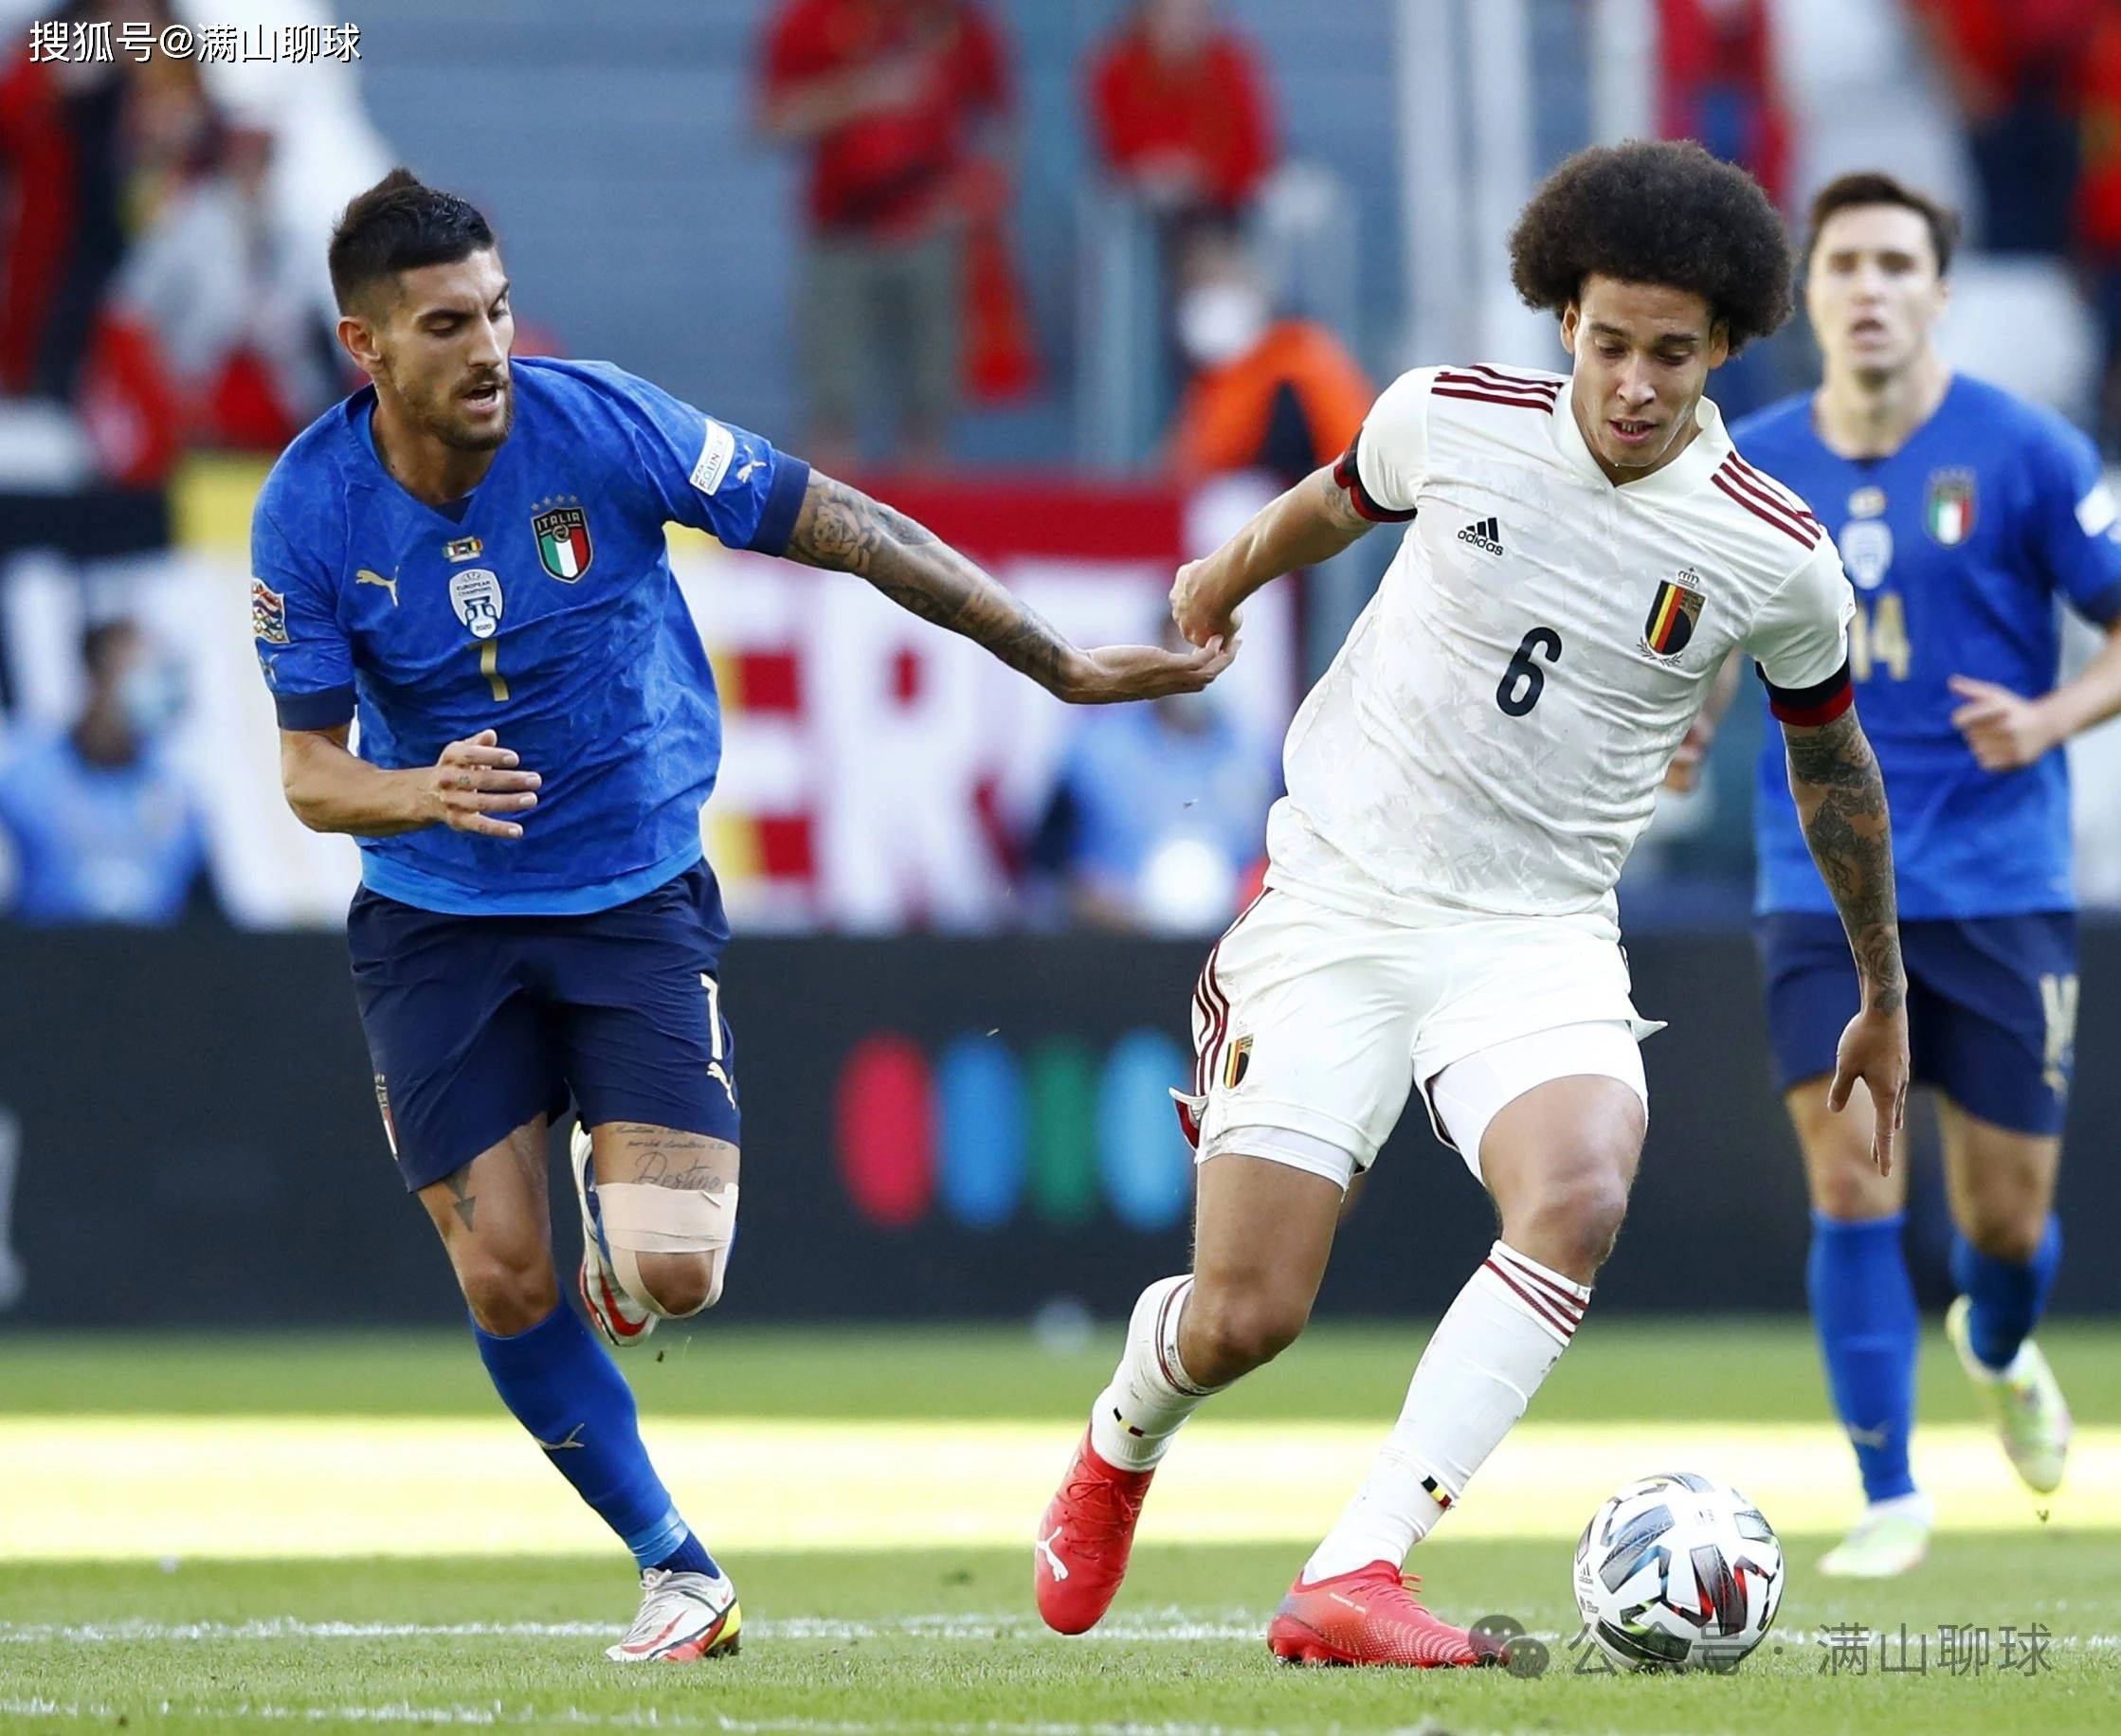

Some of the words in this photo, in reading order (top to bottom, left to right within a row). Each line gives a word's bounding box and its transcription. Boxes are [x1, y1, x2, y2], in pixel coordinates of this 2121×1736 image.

[536, 512, 581, 532] ITALIA
[1458, 530, 1504, 556] adidas
[1496, 626, 1562, 717] 6
